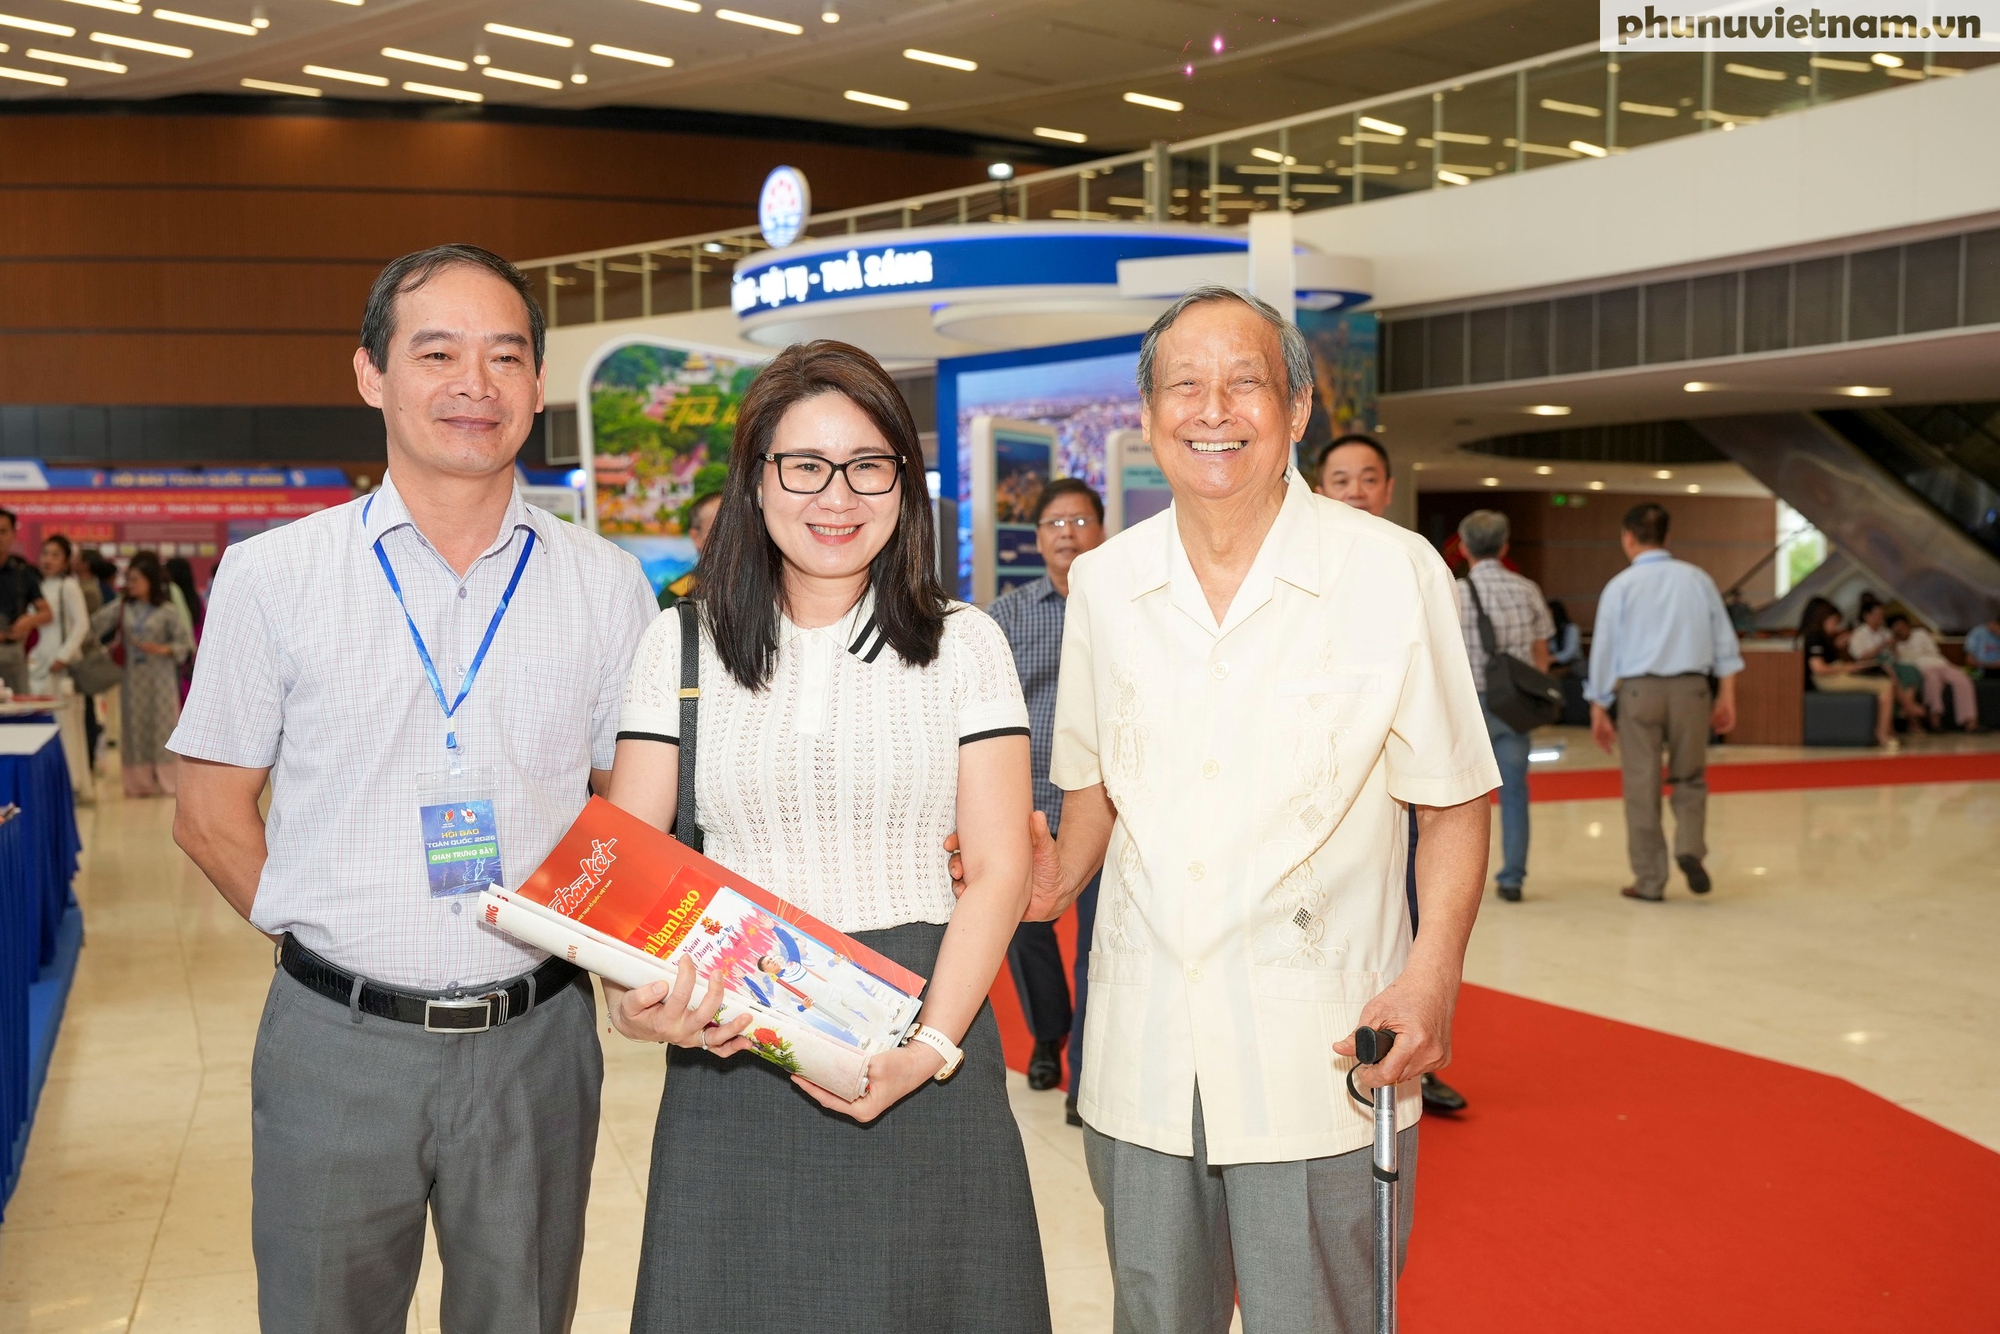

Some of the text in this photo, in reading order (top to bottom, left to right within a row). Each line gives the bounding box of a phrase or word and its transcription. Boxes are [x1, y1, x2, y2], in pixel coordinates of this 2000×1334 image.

[864, 248, 933, 287] SÁNG
[427, 835, 496, 848] TOÀN QUỐC 2026
[431, 846, 495, 861] GIAN TRƯNG BÀY
[647, 919, 681, 948] làm
[667, 889, 700, 921] báo
